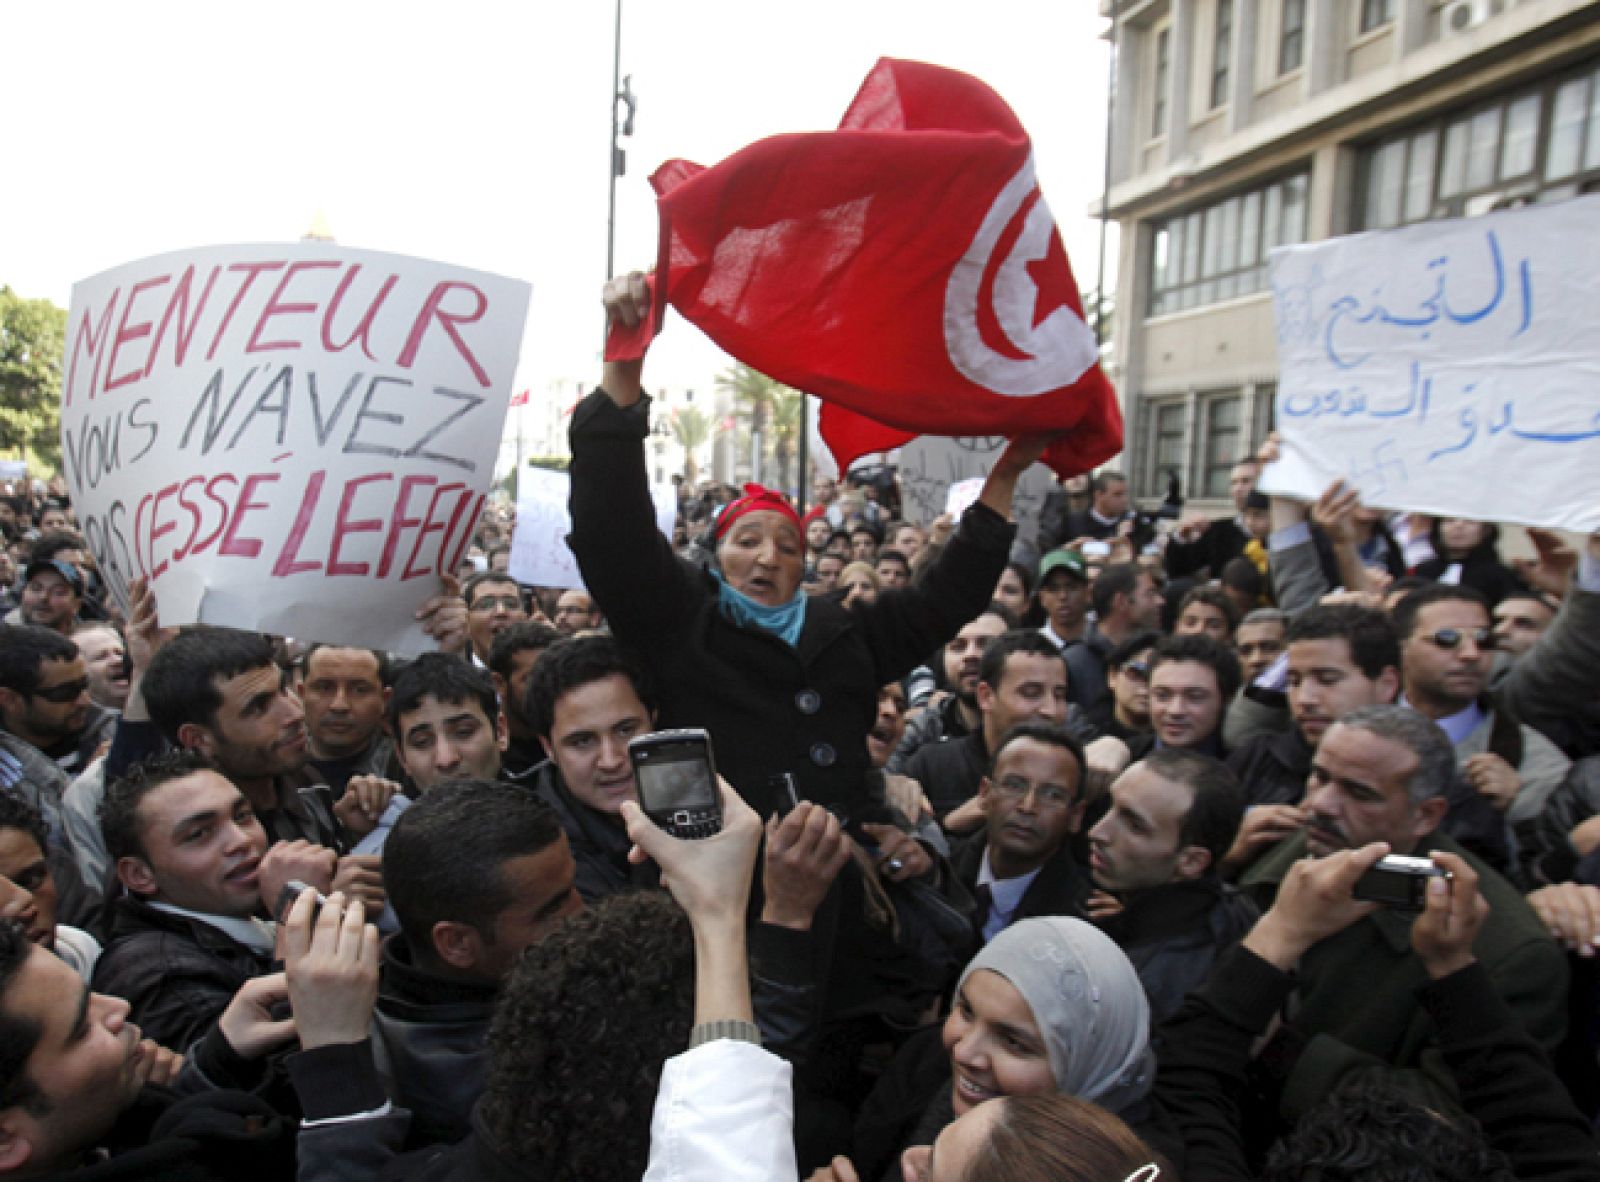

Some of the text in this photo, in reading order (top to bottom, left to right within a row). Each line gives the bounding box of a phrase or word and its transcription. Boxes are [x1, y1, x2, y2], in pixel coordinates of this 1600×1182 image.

[66, 261, 492, 406] MENTEUR
[65, 361, 486, 495] VOUS N'AVEZ
